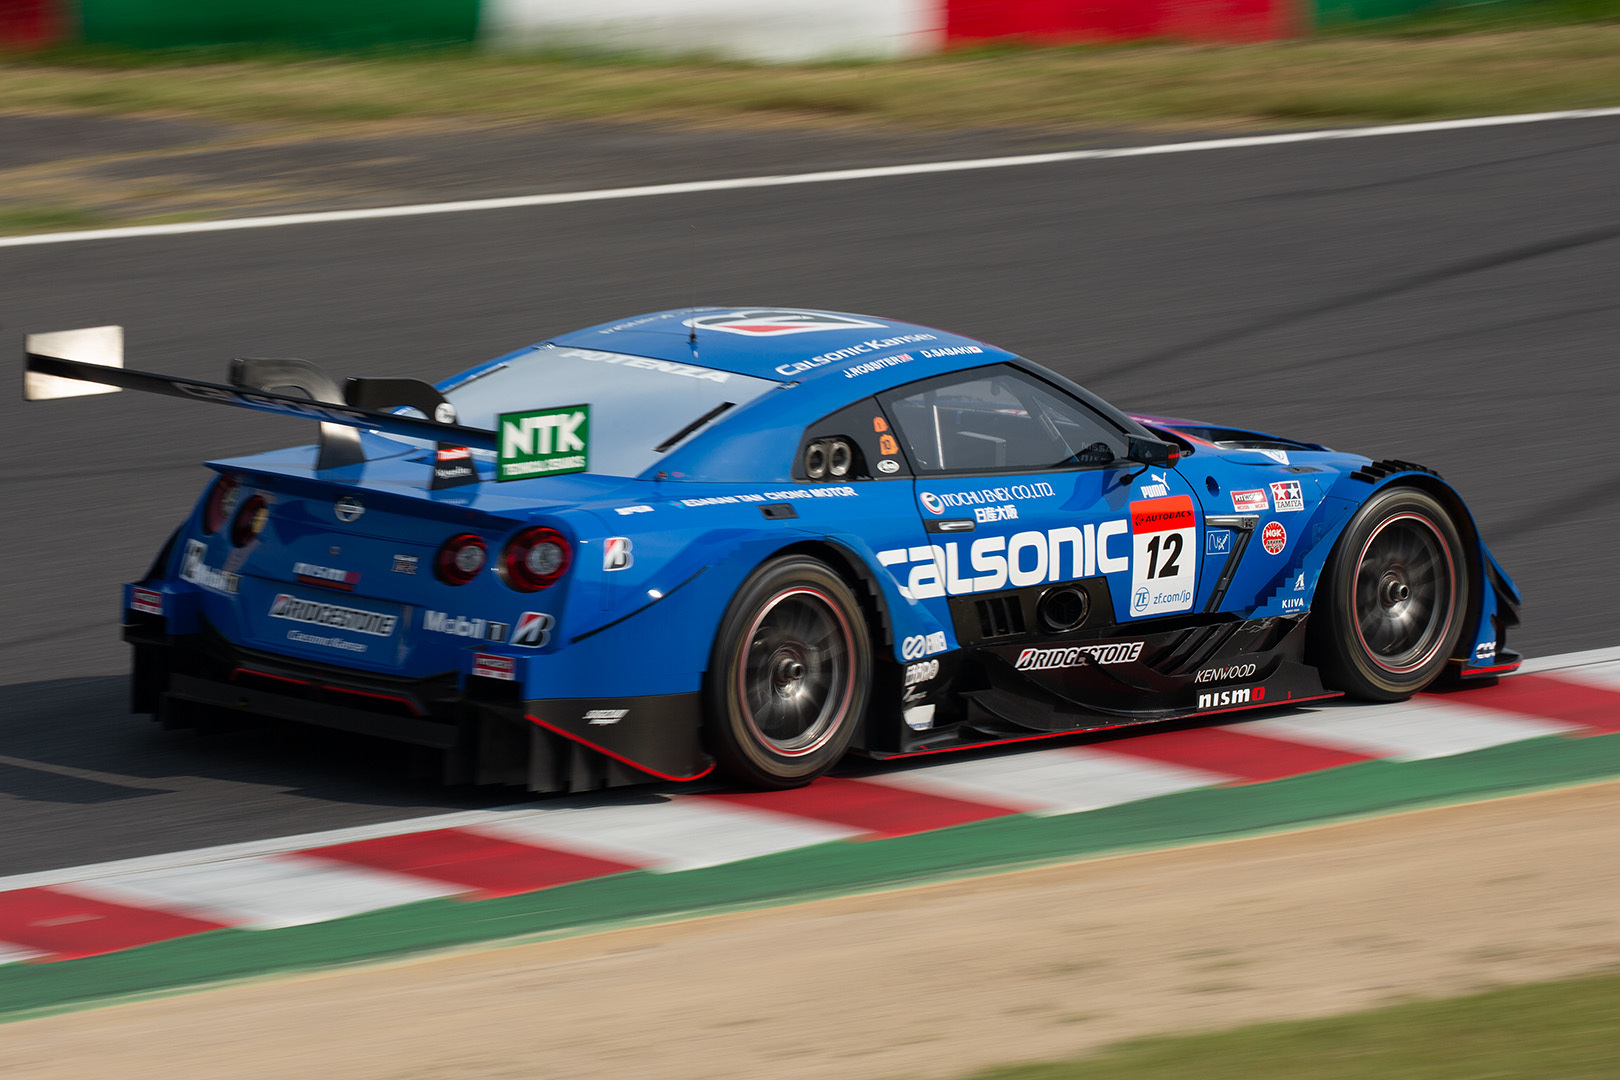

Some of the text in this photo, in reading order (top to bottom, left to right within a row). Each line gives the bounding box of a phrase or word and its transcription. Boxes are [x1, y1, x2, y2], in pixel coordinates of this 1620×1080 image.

[502, 411, 586, 458] NTK
[763, 489, 812, 501] CHONG
[808, 486, 860, 498] MOTOR
[940, 490, 985, 507] ITOCHU
[981, 487, 1014, 503] ENEX
[1140, 484, 1168, 498] PUMA
[973, 504, 1019, 523] 日産大阪
[1145, 510, 1192, 522] AUTOBACS
[1265, 529, 1282, 538] NGK
[1147, 533, 1183, 580] 12
[1153, 589, 1191, 605] zf.com/jp
[1281, 598, 1304, 609] KIIVA
[423, 610, 486, 639] Mobil
[1014, 642, 1145, 671] BRIDGESTONE
[1194, 663, 1256, 683] KENWOOD
